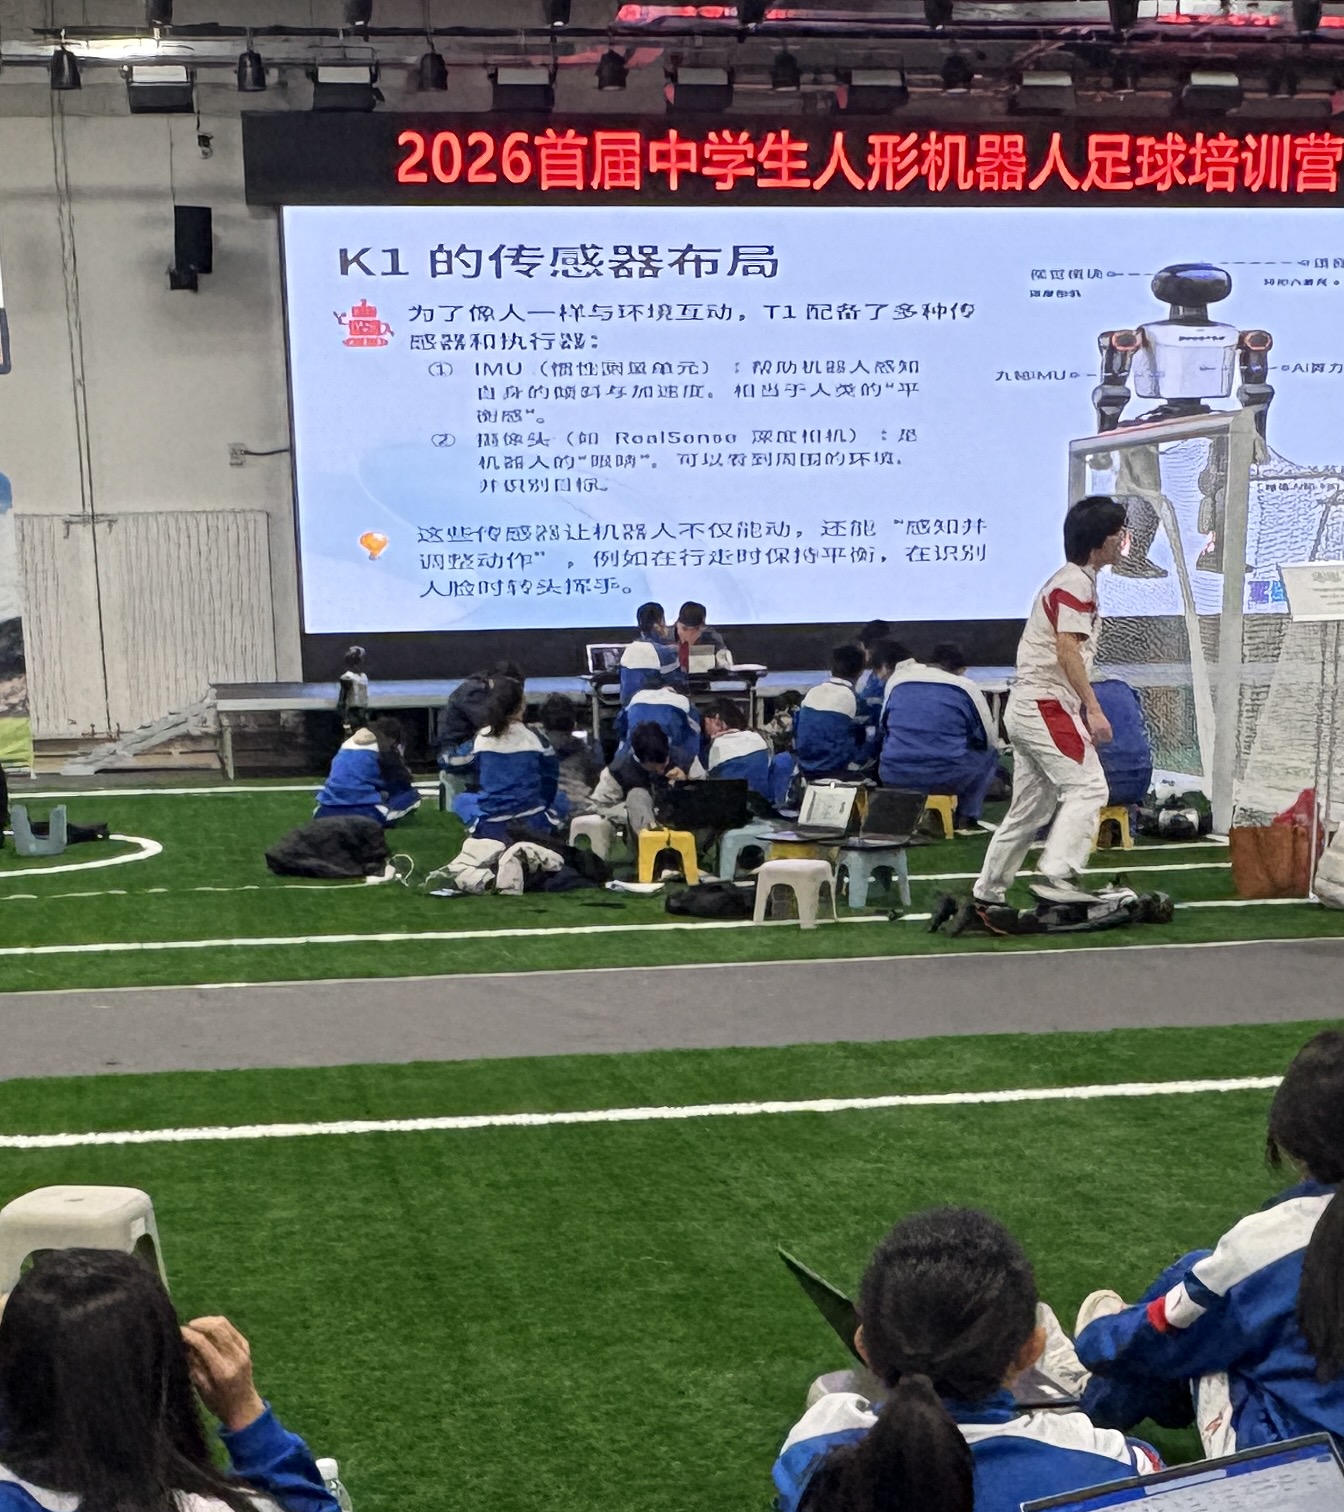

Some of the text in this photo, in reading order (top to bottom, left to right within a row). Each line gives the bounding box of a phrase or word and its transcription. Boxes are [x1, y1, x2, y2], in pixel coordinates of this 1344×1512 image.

[338, 242, 779, 280] K1 的传感器布局
